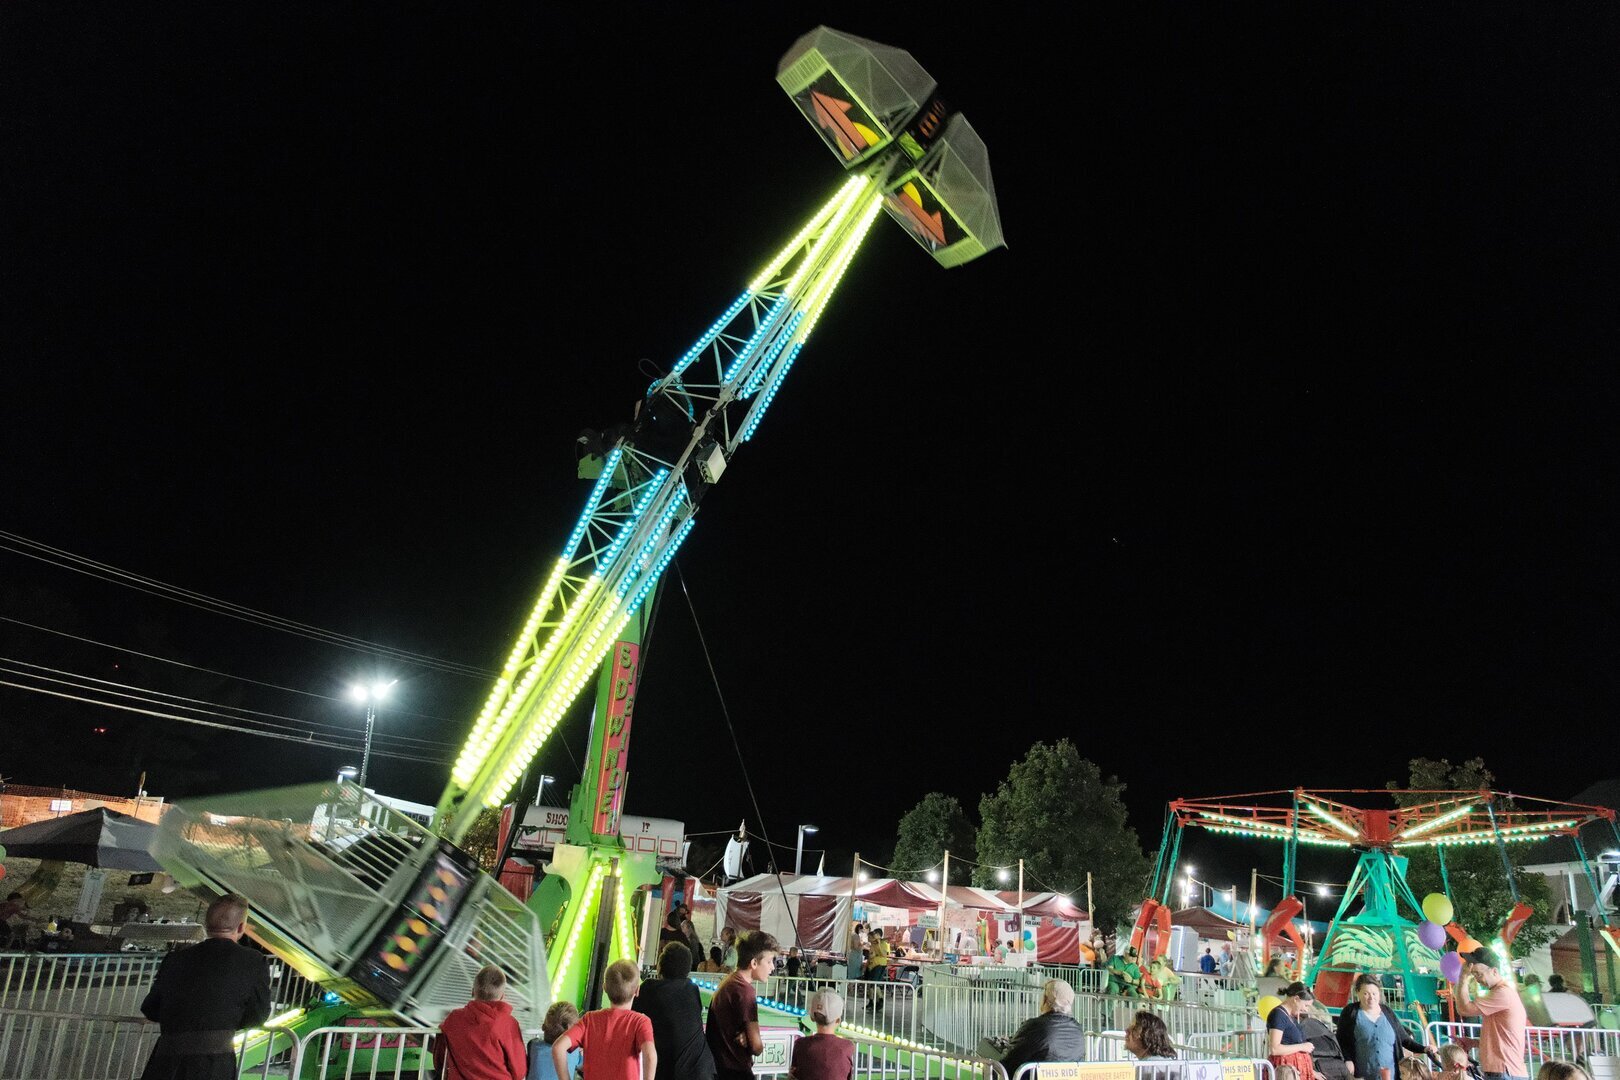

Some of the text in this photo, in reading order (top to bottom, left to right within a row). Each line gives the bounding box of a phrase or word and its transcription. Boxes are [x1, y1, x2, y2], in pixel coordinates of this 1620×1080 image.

[546, 812, 569, 826] SHOO
[1041, 1068, 1078, 1078] THIS RIDE
[1237, 1064, 1251, 1073] RIDE
